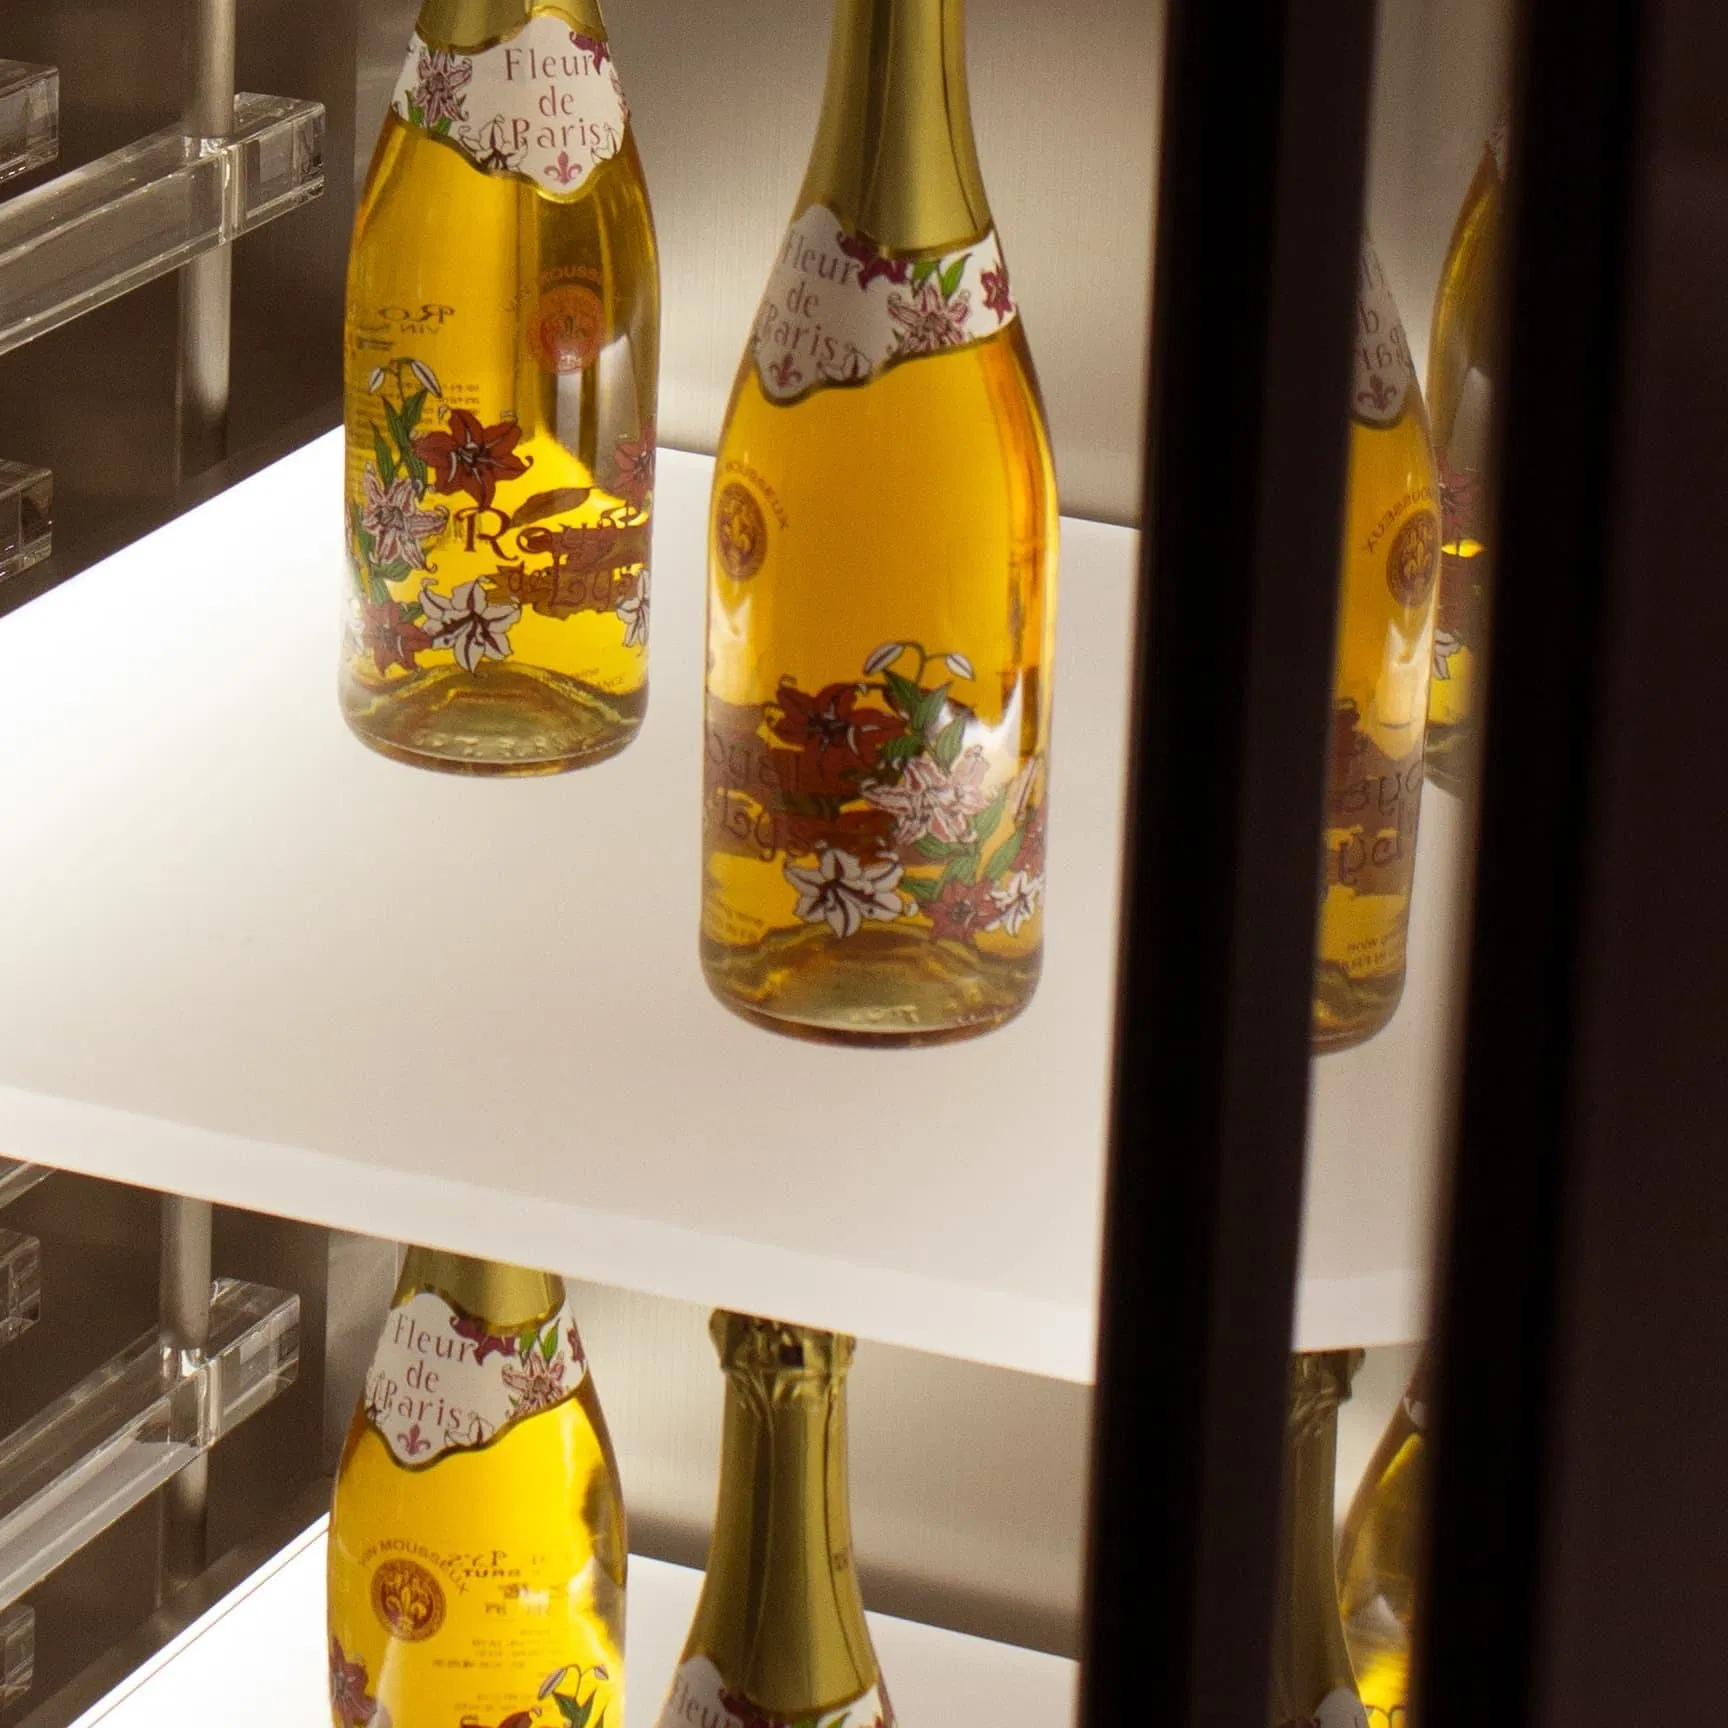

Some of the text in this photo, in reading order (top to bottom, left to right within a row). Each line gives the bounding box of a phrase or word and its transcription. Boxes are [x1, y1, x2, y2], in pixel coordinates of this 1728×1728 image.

[503, 48, 594, 81] Fleur
[538, 85, 575, 117] de
[510, 117, 601, 149] Paris
[781, 230, 860, 286] Fleur
[786, 281, 821, 319] de
[392, 1312, 474, 1364] Fleur
[405, 1362, 441, 1394] de
[381, 1380, 462, 1429] Paris
